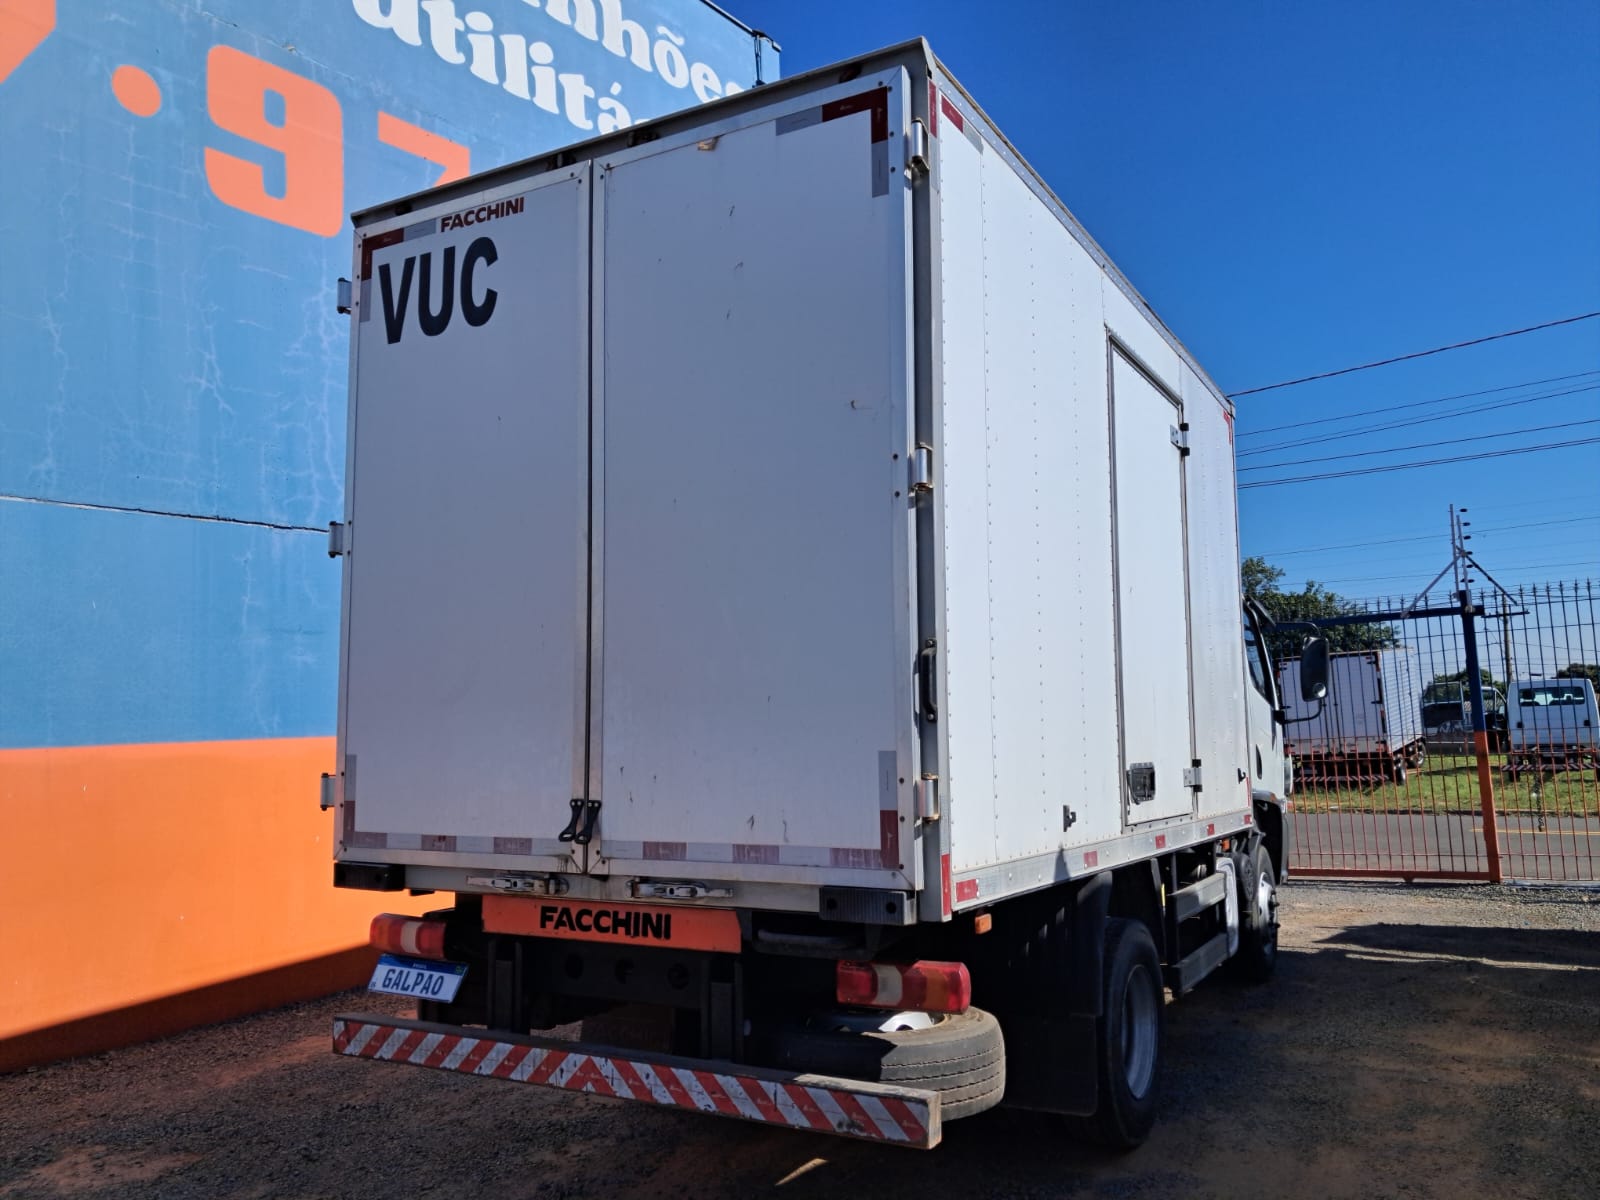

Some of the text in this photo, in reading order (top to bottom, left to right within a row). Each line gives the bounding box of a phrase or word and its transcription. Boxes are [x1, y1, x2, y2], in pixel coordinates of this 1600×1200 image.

[353, 0, 651, 135] utilitá
[440, 196, 524, 233] FACCHINI
[378, 236, 498, 345] VUC
[540, 905, 671, 940] FACCHINI
[382, 968, 444, 996] GALPAO
